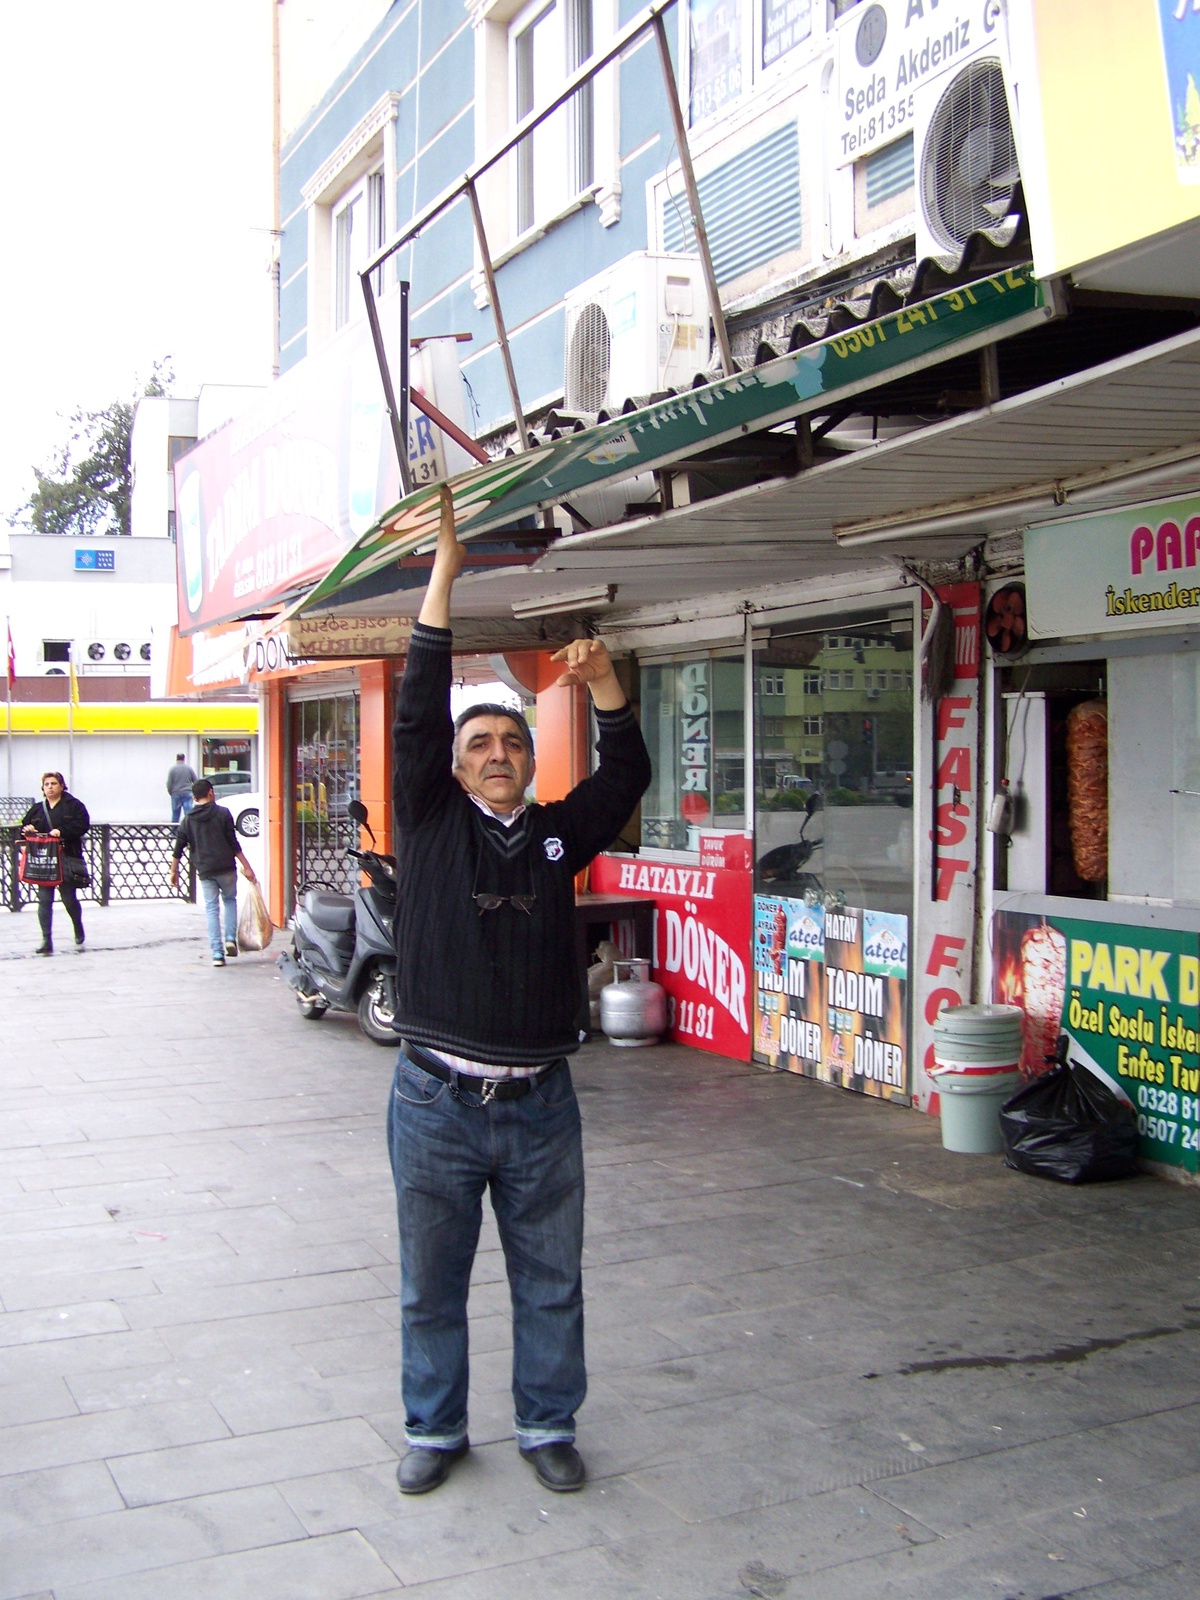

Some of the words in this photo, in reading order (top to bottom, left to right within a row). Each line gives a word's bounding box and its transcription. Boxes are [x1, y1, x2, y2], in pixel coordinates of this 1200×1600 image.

[845, 73, 886, 121] Seda
[896, 16, 970, 91] Akdeniz
[1106, 582, 1200, 616] İskender
[929, 696, 973, 900] FAST
[619, 863, 716, 899] HATAYLI
[825, 912, 858, 944] HATAY
[665, 900, 749, 1035] DÖNER
[826, 966, 883, 1017] TADIM
[1070, 938, 1172, 1003] PARK
[695, 1002, 715, 1040] 31
[780, 1010, 821, 1063] DÖNER
[1069, 990, 1104, 1035] Özel
[1108, 1004, 1154, 1045] Soslu
[854, 1030, 903, 1088] DÖNER
[1117, 1043, 1165, 1084] Enfes
[1137, 1084, 1178, 1116] 0328
[1137, 1113, 1178, 1144] 0507
